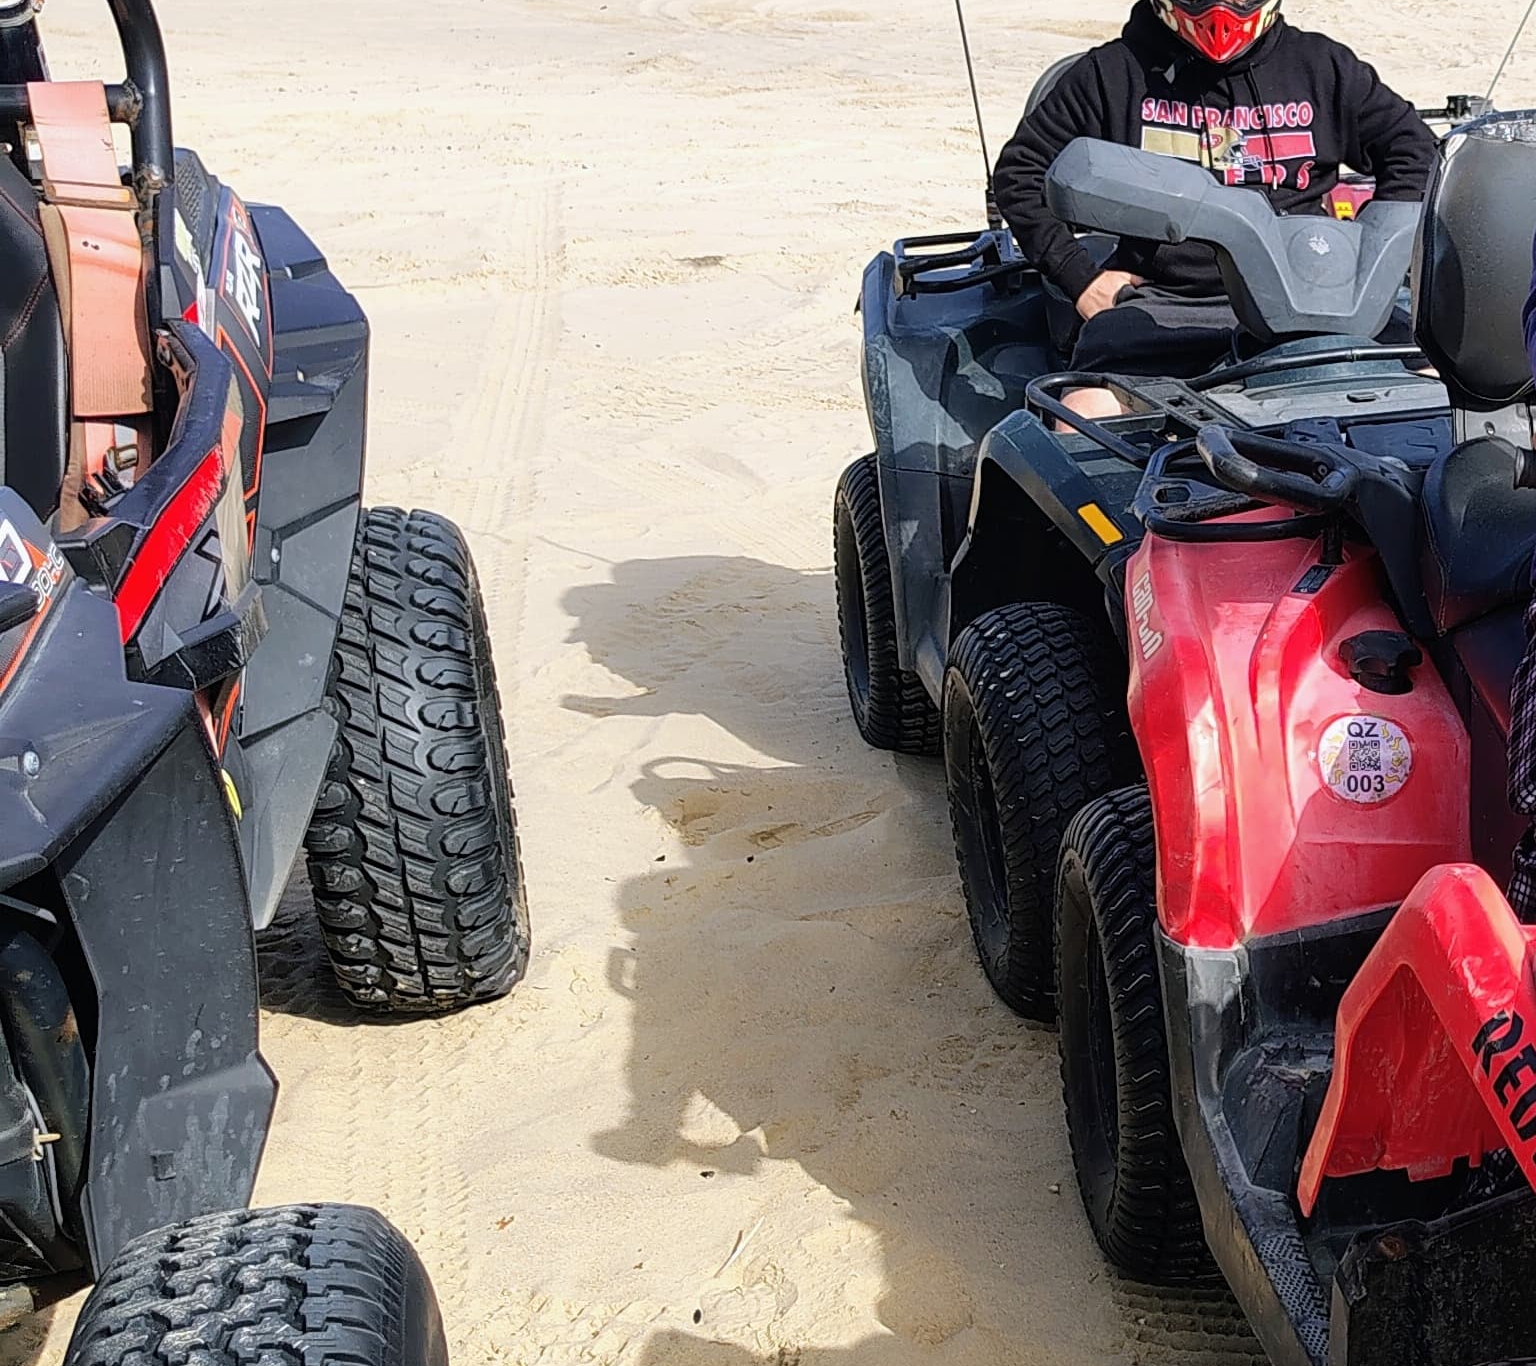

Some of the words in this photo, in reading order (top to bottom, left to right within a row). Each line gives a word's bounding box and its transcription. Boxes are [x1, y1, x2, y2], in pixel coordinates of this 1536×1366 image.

[1141, 97, 1188, 125] SAN
[1191, 101, 1314, 129] FRANCISCO
[1347, 721, 1380, 738] QZ
[1347, 774, 1385, 792] 003
